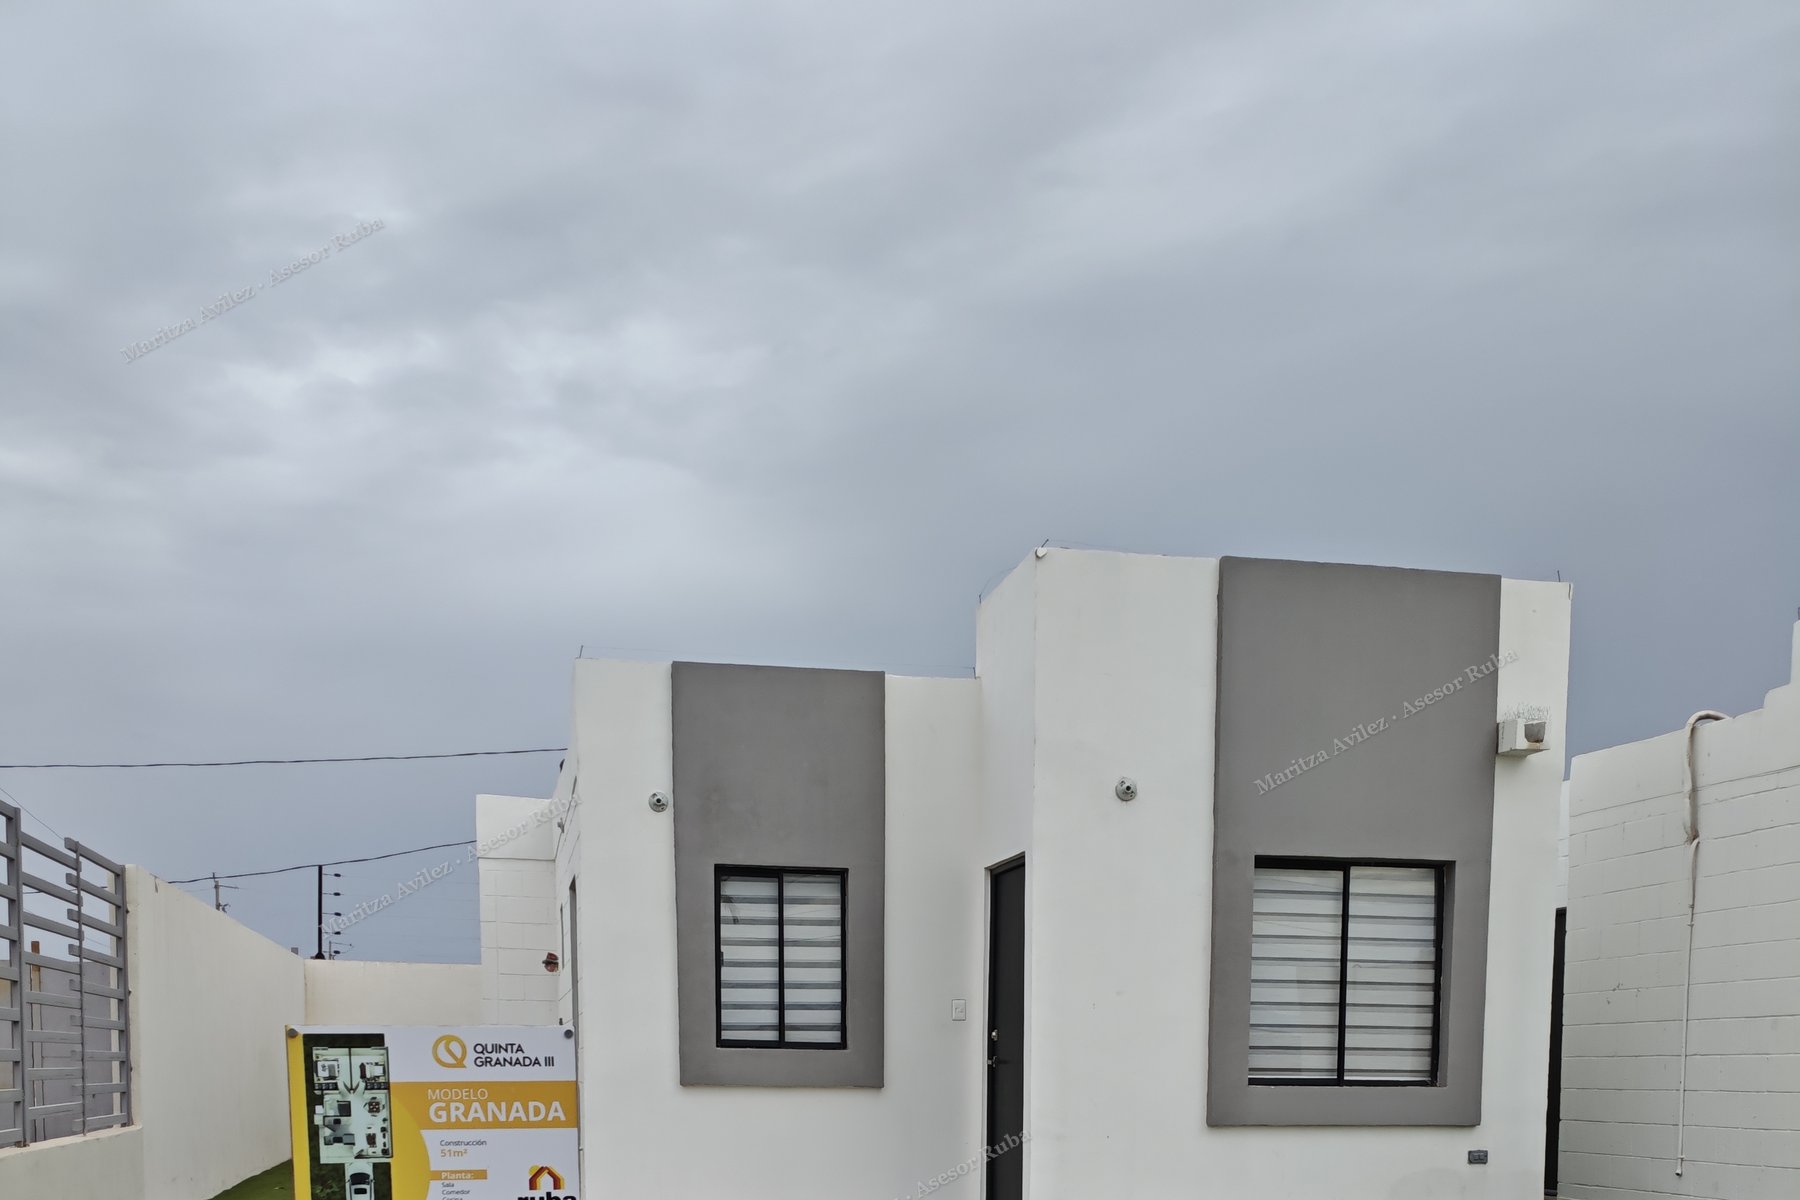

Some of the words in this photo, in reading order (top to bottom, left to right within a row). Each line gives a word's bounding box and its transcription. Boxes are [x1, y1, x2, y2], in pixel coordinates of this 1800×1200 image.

[473, 1043, 525, 1055] QUINTA
[473, 1056, 542, 1068] GRANADA
[544, 1056, 555, 1067] III
[427, 1088, 489, 1101] MODELO
[428, 1101, 567, 1123] GRANADA
[439, 1139, 488, 1147] Construcción
[441, 1171, 475, 1180] Planta:
